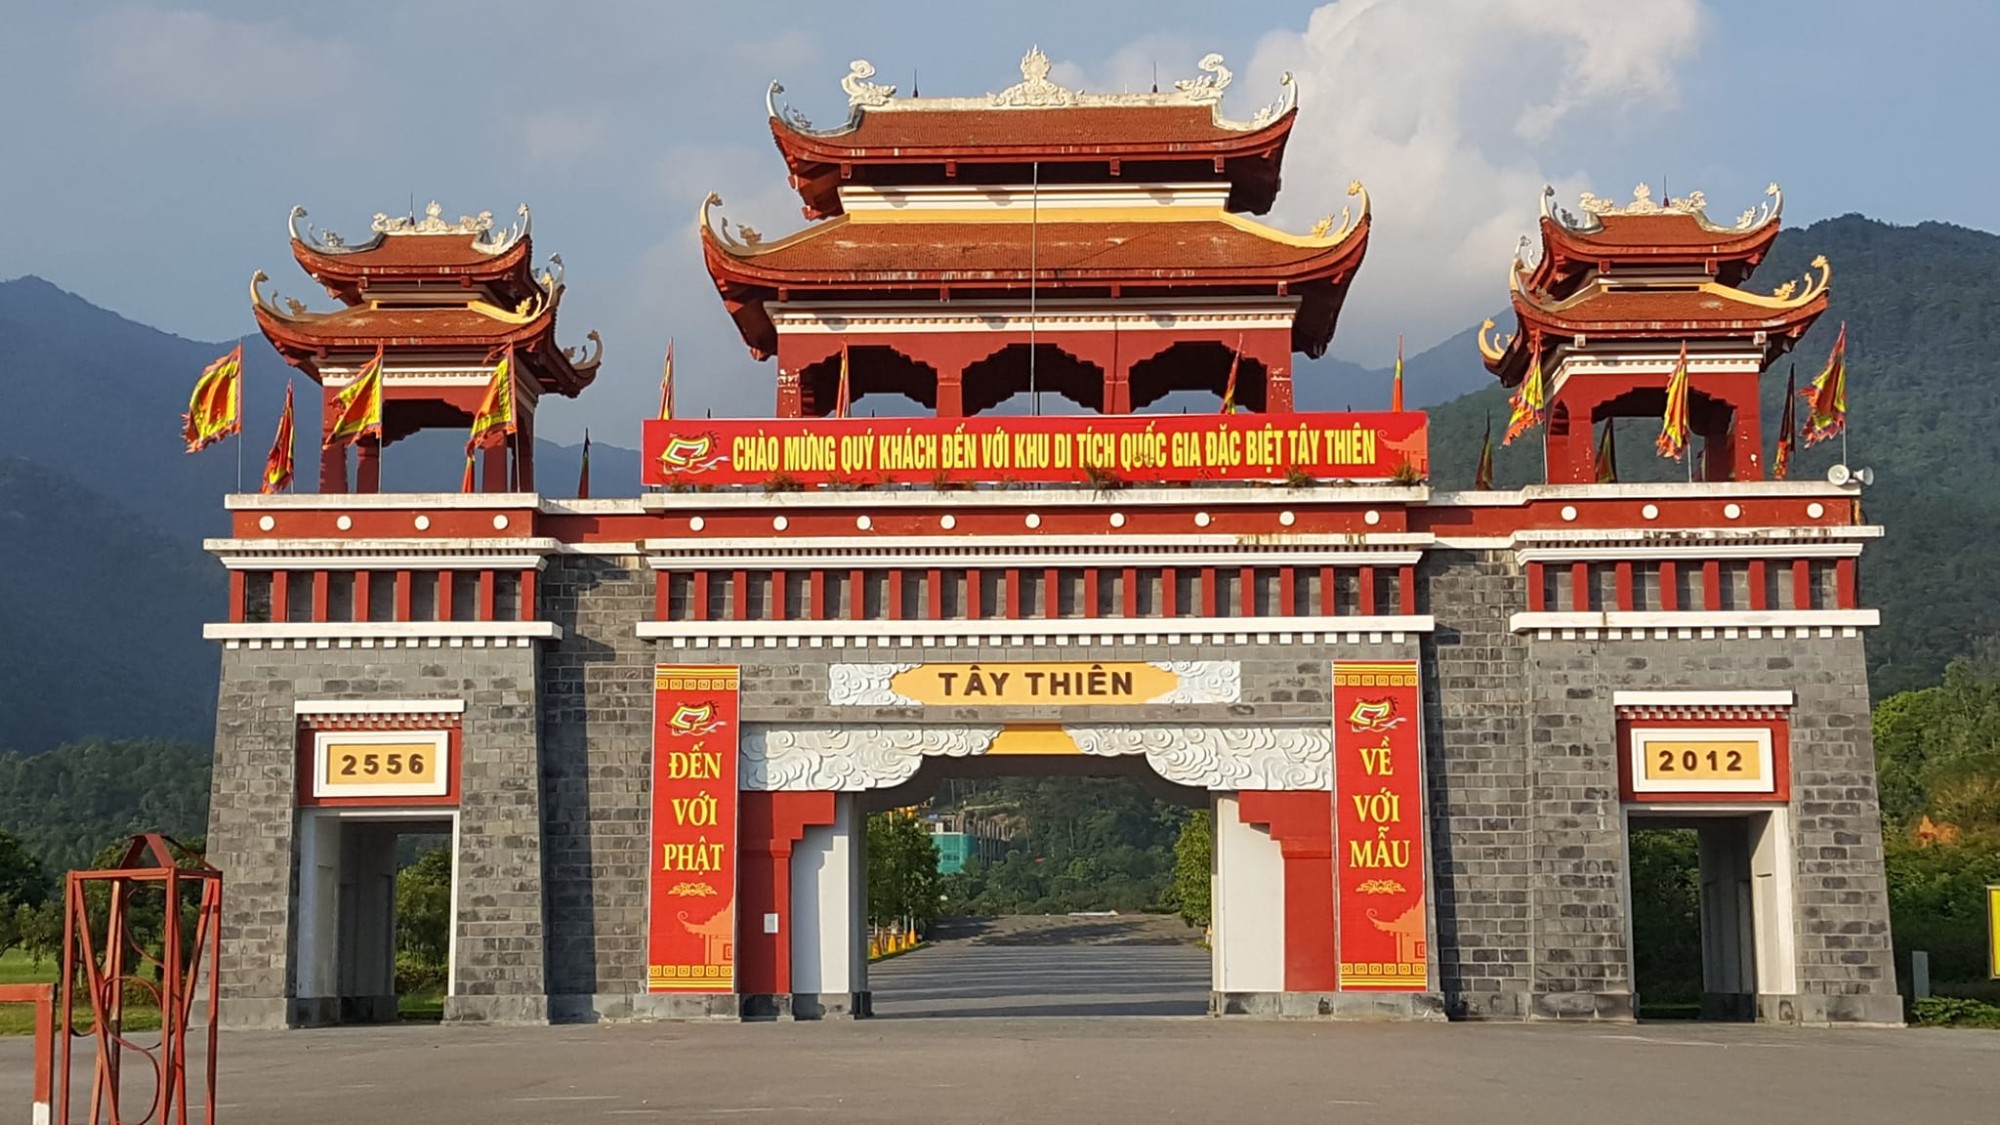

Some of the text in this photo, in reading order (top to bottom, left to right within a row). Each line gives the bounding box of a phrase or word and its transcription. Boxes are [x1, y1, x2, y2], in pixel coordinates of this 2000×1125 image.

[732, 420, 1376, 475] CHÀO MỪNG QUÝ KHÁCH ĐẾN VỚI KHU DI TÍCH QUỐC GIA ĐẶC BIỆT TÂY THIÊN
[937, 664, 1133, 696] TÂY THIÊN
[340, 754, 424, 775] 2556
[668, 740, 723, 780] ĐẾN
[1358, 735, 1394, 776] VỀ
[1658, 750, 1742, 771] 2012
[671, 790, 718, 827] VỚI
[1352, 786, 1401, 823] VỚI
[662, 835, 725, 876] PHẬT
[1349, 825, 1411, 868] MẪU
